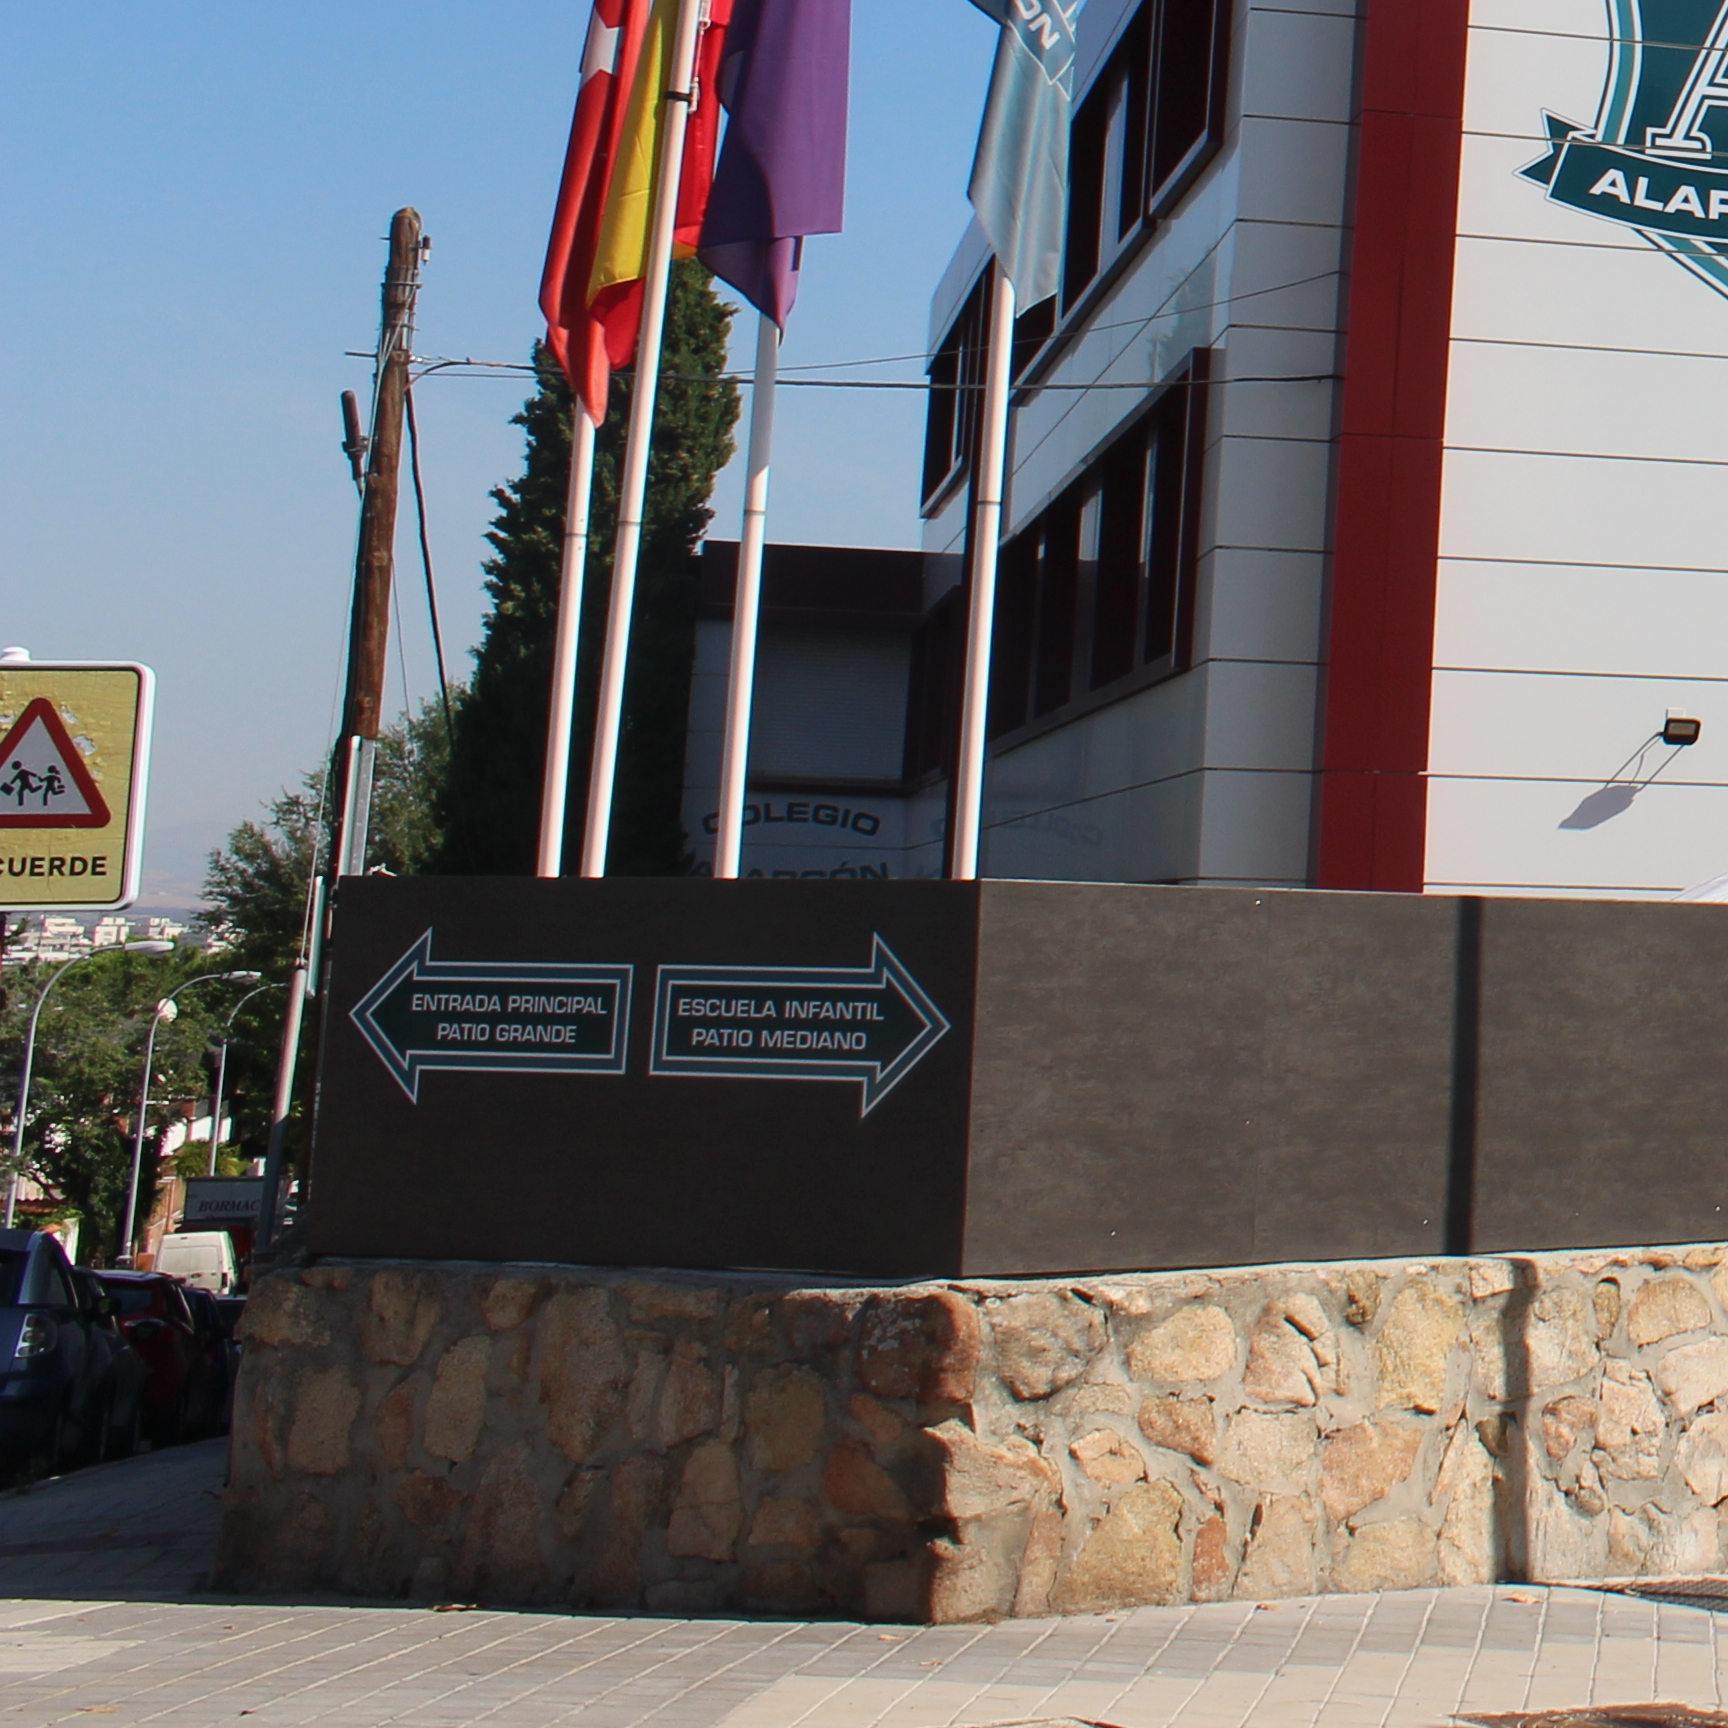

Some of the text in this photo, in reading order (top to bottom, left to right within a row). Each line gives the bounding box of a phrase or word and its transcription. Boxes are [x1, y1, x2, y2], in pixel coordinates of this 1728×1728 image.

[0, 856, 107, 877] UERDE
[411, 993, 608, 1014] ENTRADA PRINCIPAL
[677, 998, 884, 1020] ESCUELA INFANTIL
[437, 1023, 577, 1043] PATIO GRANDE
[691, 1028, 867, 1050] PATIO MEDIANO
